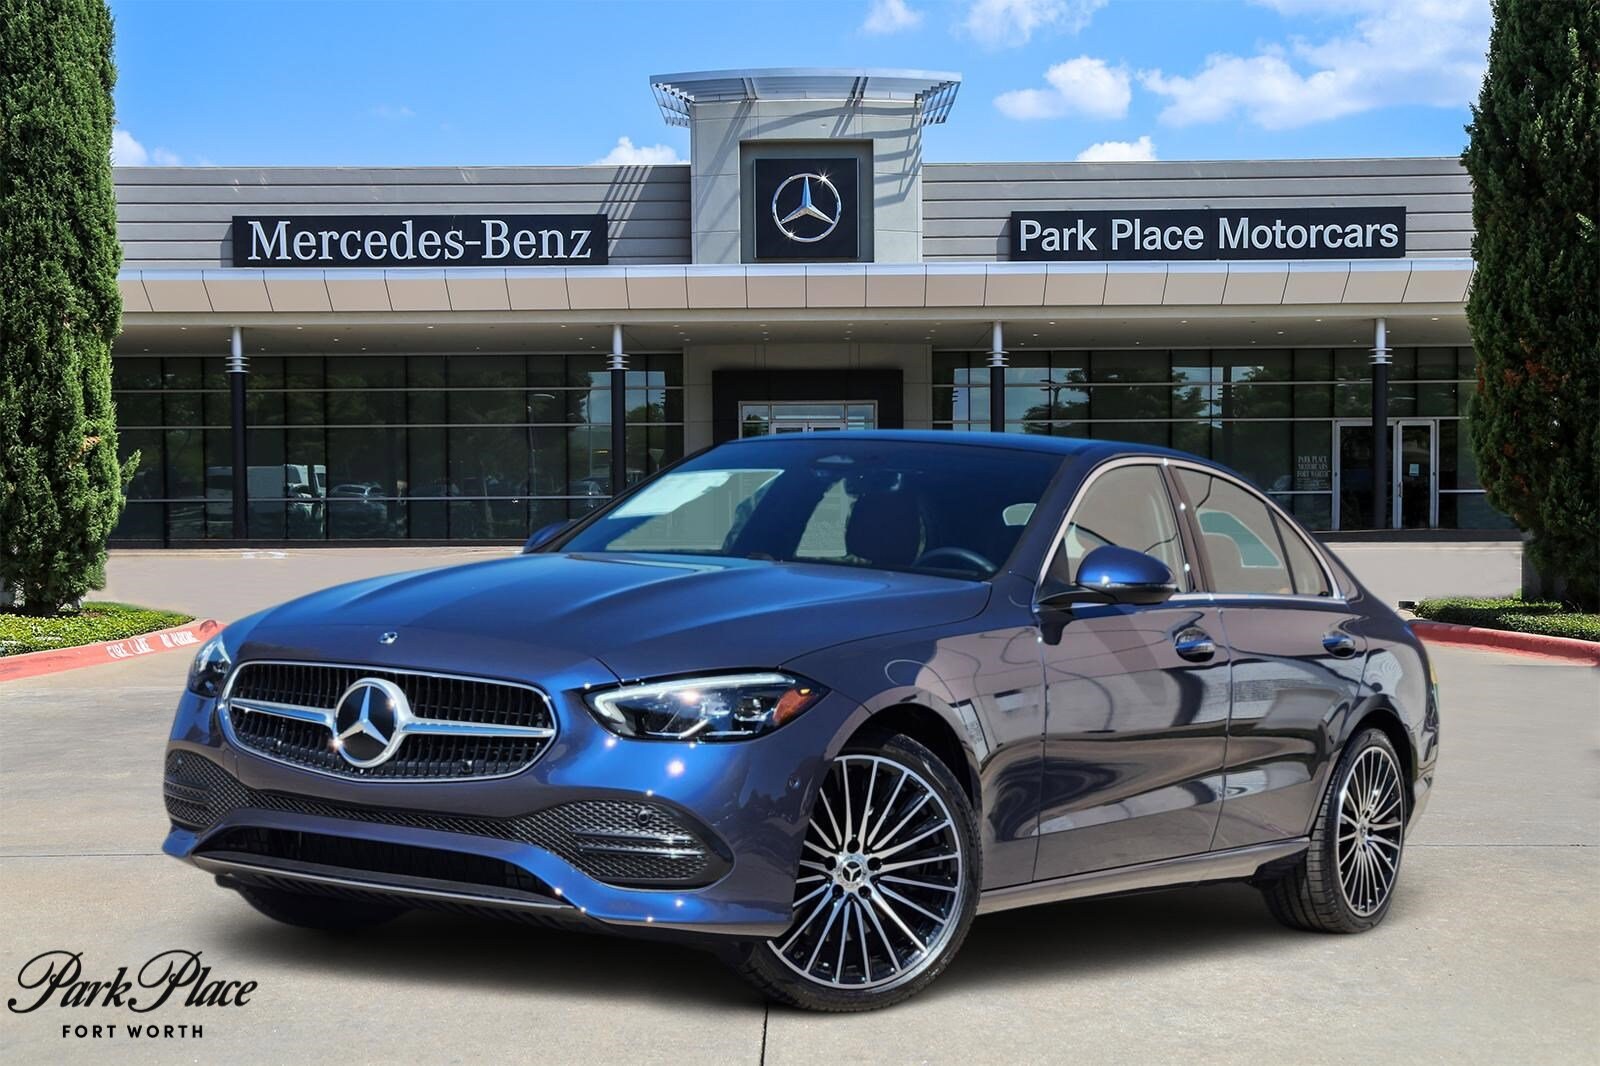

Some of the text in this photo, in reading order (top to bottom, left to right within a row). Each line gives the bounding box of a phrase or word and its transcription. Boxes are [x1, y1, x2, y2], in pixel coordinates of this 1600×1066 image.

[248, 219, 592, 260] Mercedes-Benz
[1020, 217, 1399, 251] Park Place Motorcars
